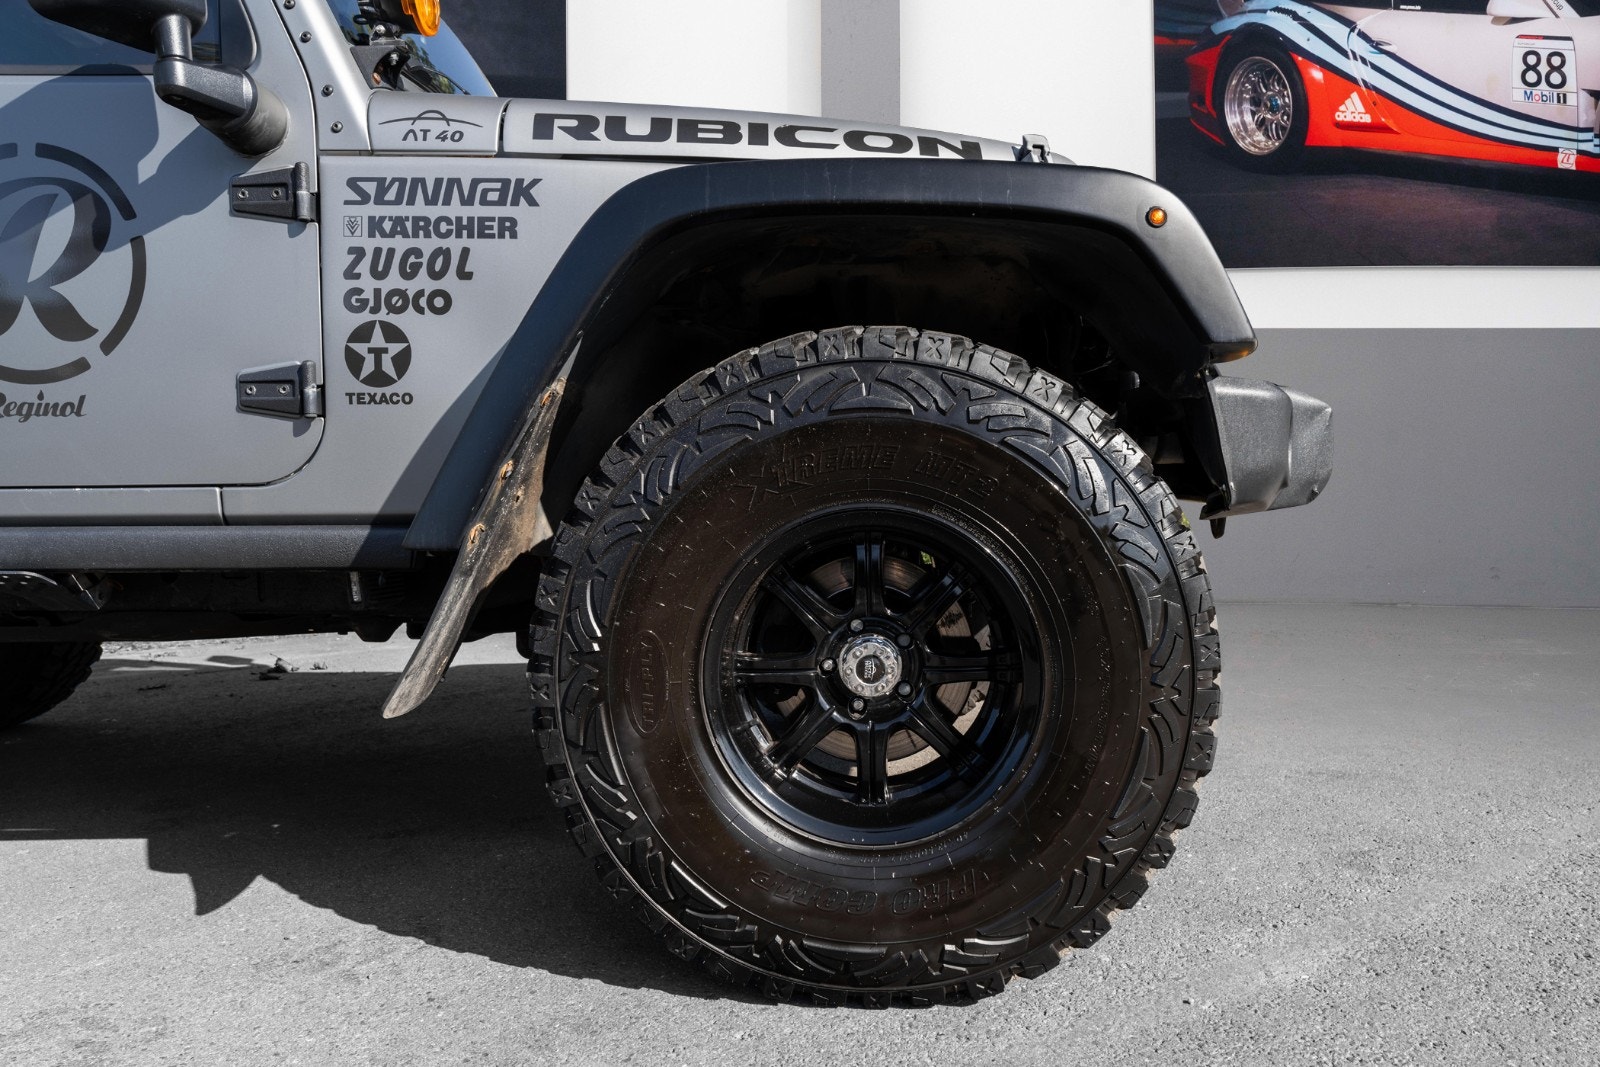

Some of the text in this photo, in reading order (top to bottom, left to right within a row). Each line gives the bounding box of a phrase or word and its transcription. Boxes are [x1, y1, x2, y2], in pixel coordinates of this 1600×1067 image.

[1520, 50, 1567, 89] 88
[1523, 90, 1567, 104] Mobil 1
[1335, 110, 1372, 123] adidas
[435, 130, 465, 143] 40
[532, 112, 982, 160] RUBICON
[367, 215, 518, 239] KÄRCHER
[343, 287, 453, 316] GJØCO
[345, 392, 414, 405] TEXACO
